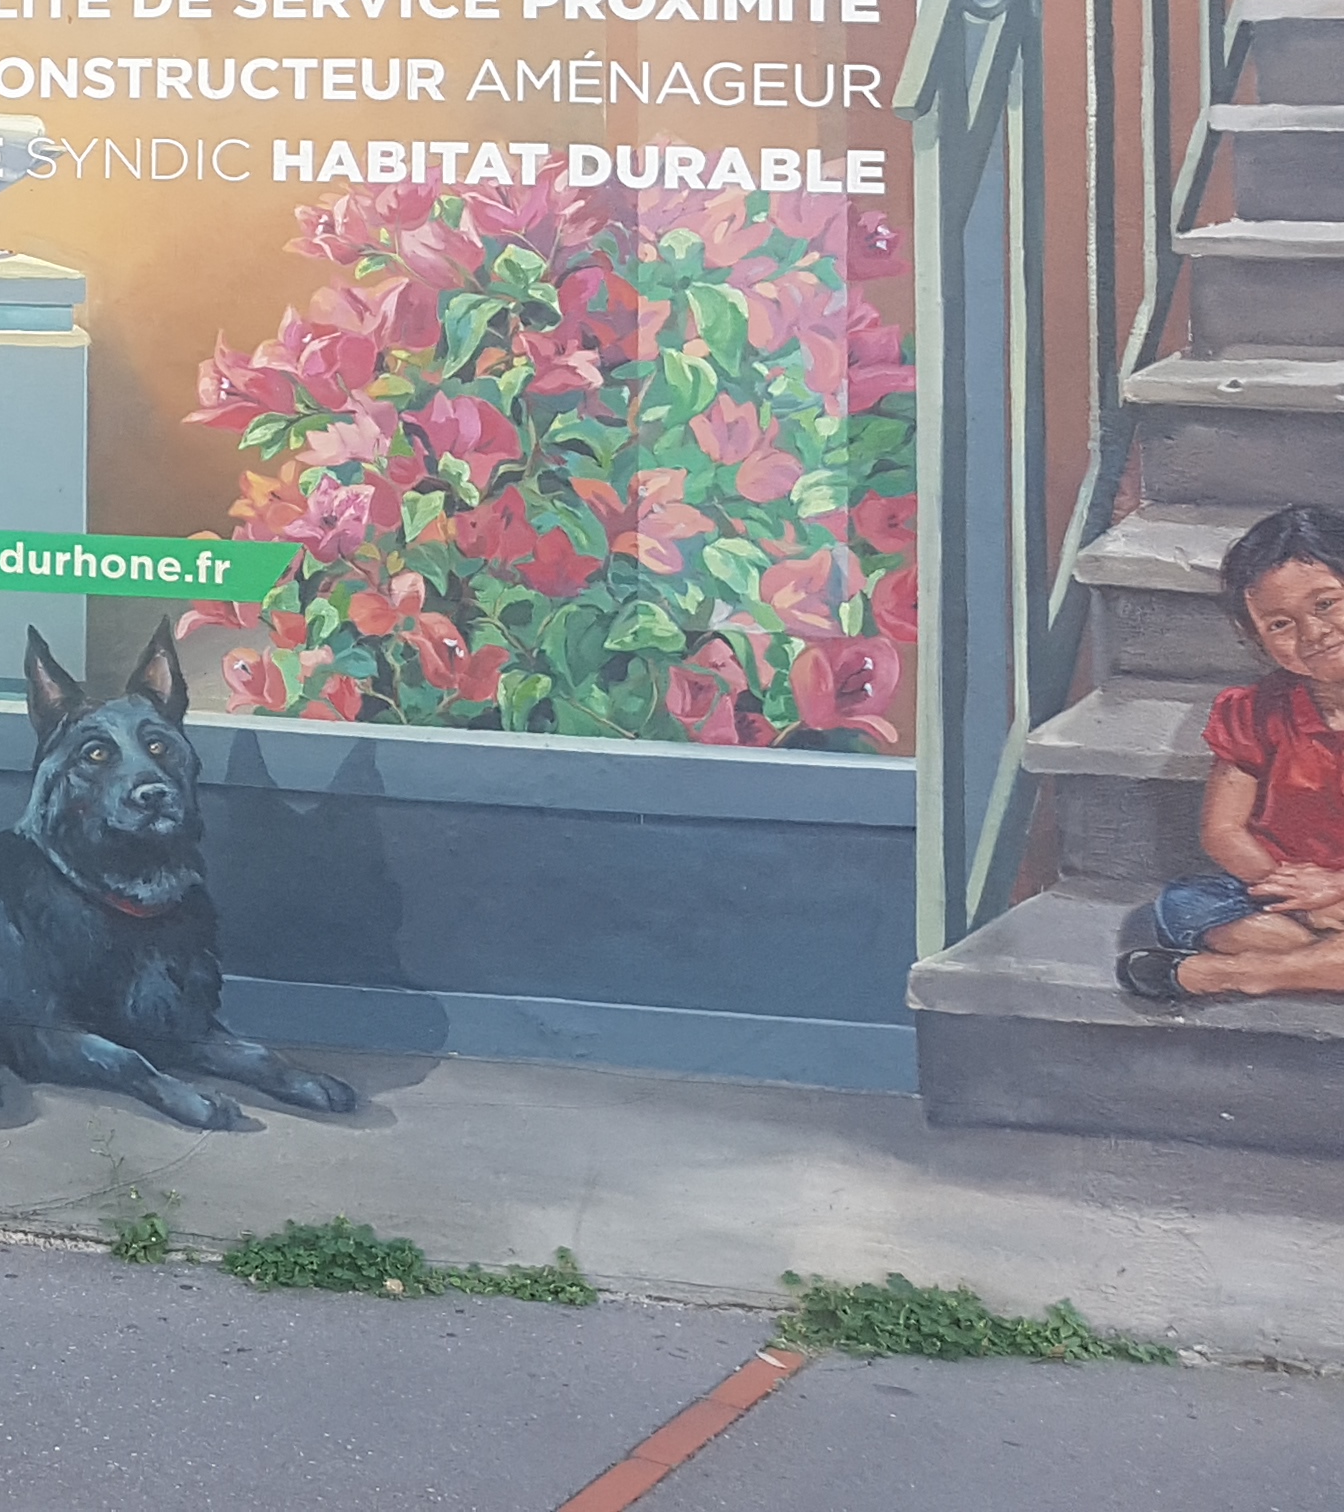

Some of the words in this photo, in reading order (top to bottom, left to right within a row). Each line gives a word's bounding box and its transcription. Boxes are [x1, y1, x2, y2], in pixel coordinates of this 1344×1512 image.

[466, 50, 882, 109] AMÉNAGEUR
[26, 137, 250, 181] SYNDIC
[273, 138, 550, 188] HABITAT
[568, 144, 886, 194] DURABLE
